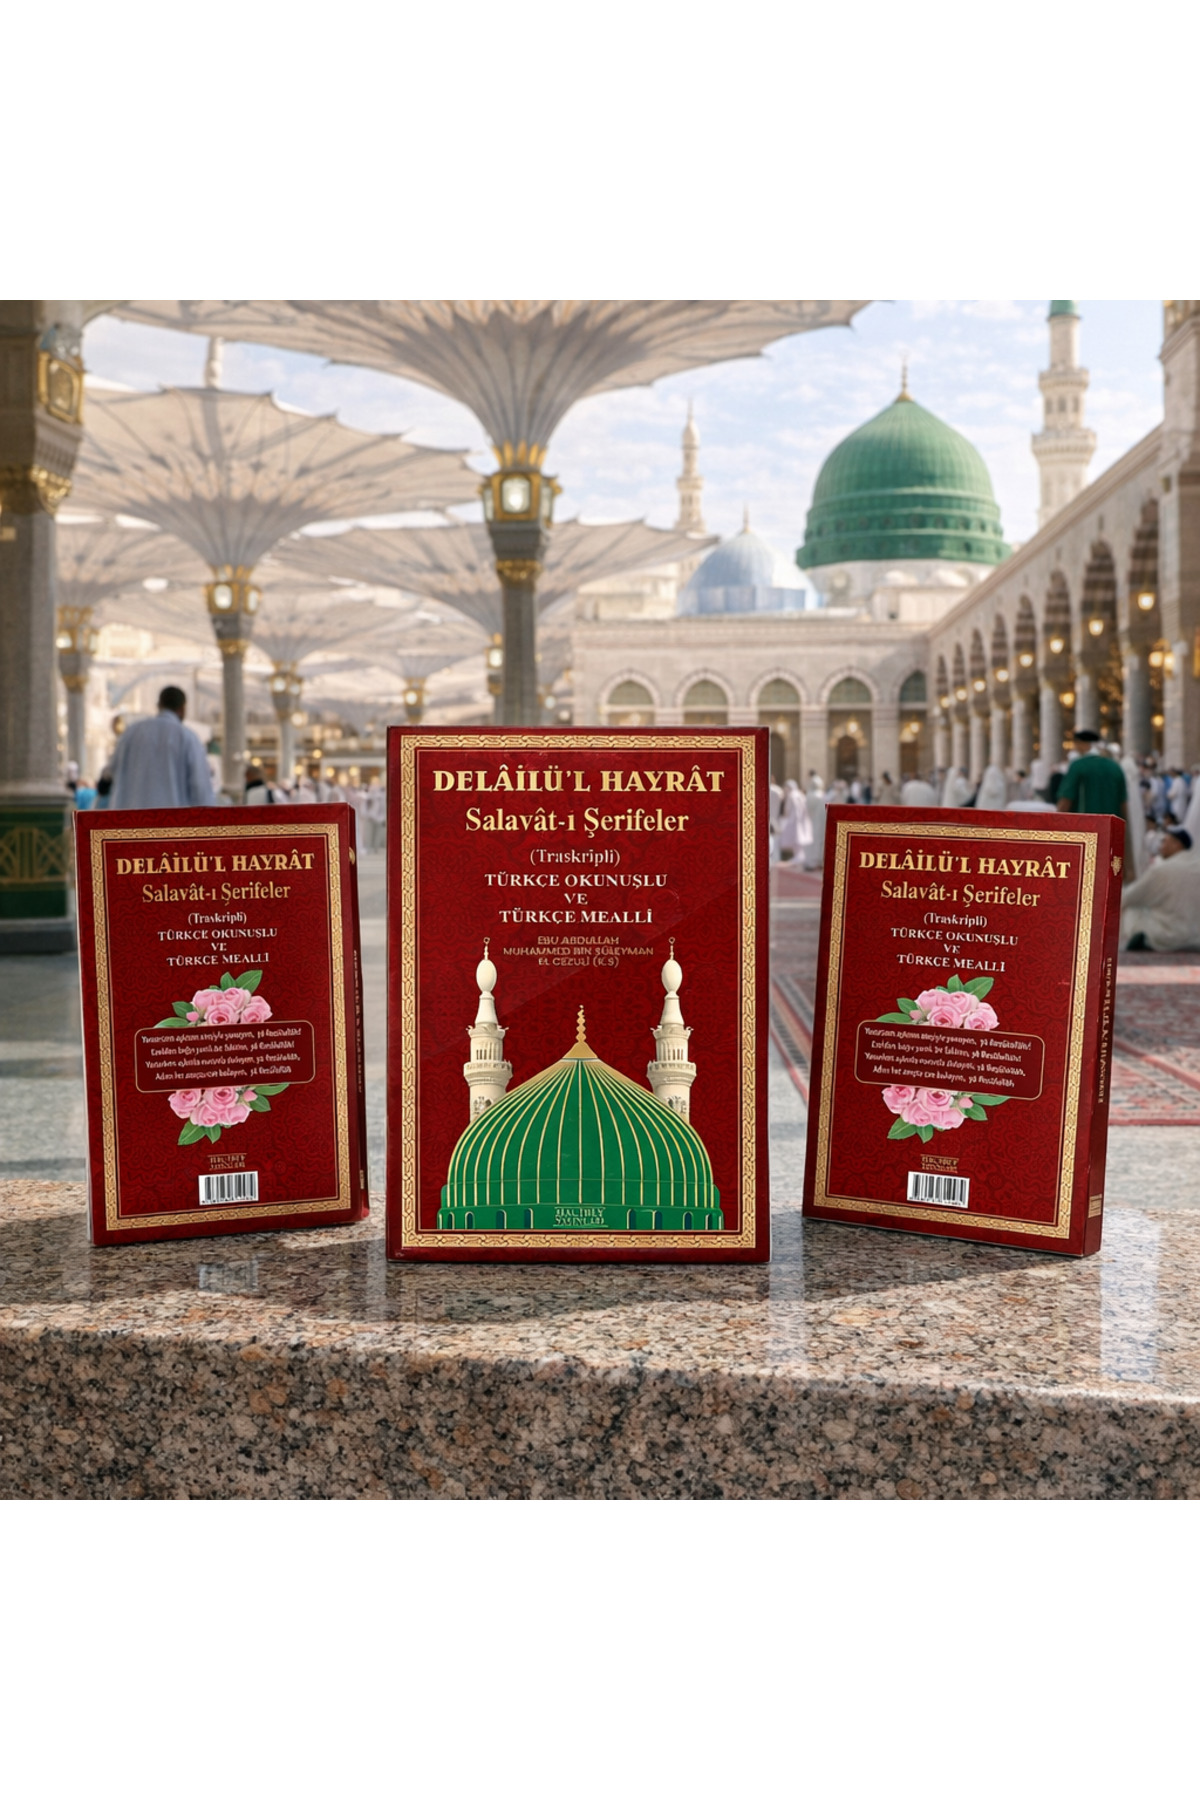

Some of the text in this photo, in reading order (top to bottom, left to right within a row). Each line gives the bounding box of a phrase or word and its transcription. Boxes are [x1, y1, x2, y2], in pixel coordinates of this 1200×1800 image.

[600, 765, 725, 792] HAYRÂT
[584, 807, 689, 838] Şerifeler
[231, 849, 314, 872] HAYRÂT
[977, 856, 1071, 879] HAYRÂT
[484, 871, 668, 889] TÜRKÇE OKUNUŞLU
[220, 881, 291, 906] Şerifeler
[564, 893, 588, 905] VE
[962, 884, 1041, 907] Şerifeler
[499, 908, 653, 924] TÜRKÇE MEALLİ
[211, 942, 227, 952] VE
[943, 943, 960, 954] VE
